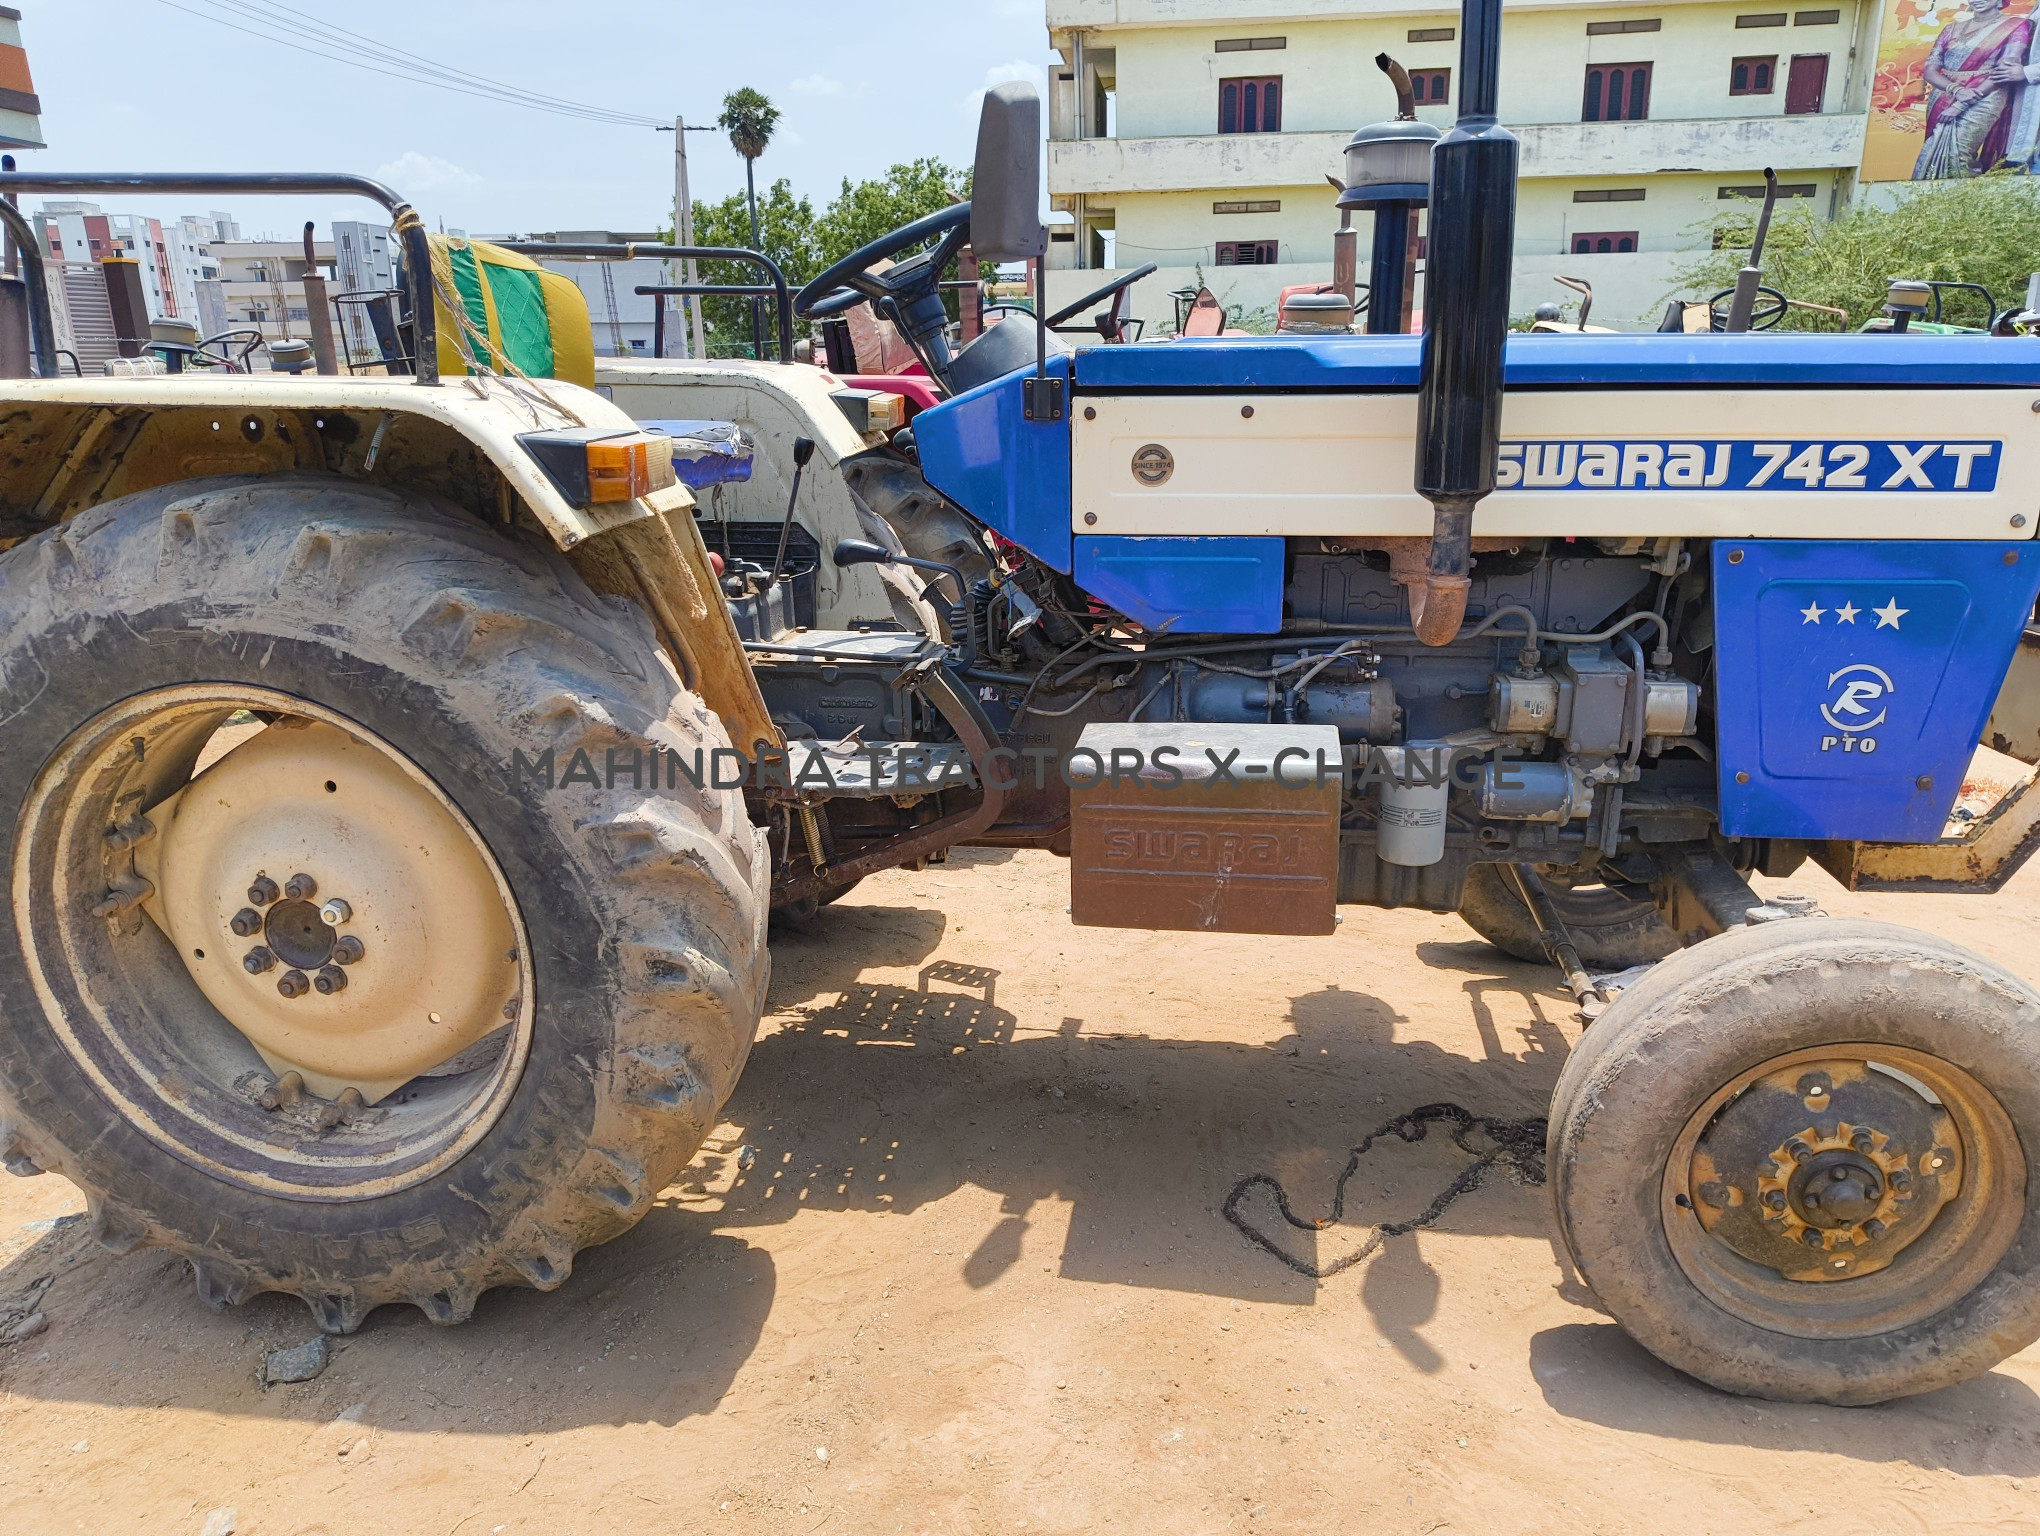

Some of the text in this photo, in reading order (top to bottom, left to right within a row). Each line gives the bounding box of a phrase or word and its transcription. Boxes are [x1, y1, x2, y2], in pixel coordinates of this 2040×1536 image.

[1133, 461, 1171, 470] SINCE 1974
[1745, 444, 1870, 488] 742
[1880, 444, 1993, 489] XT
[1820, 735, 1878, 754] PTO
